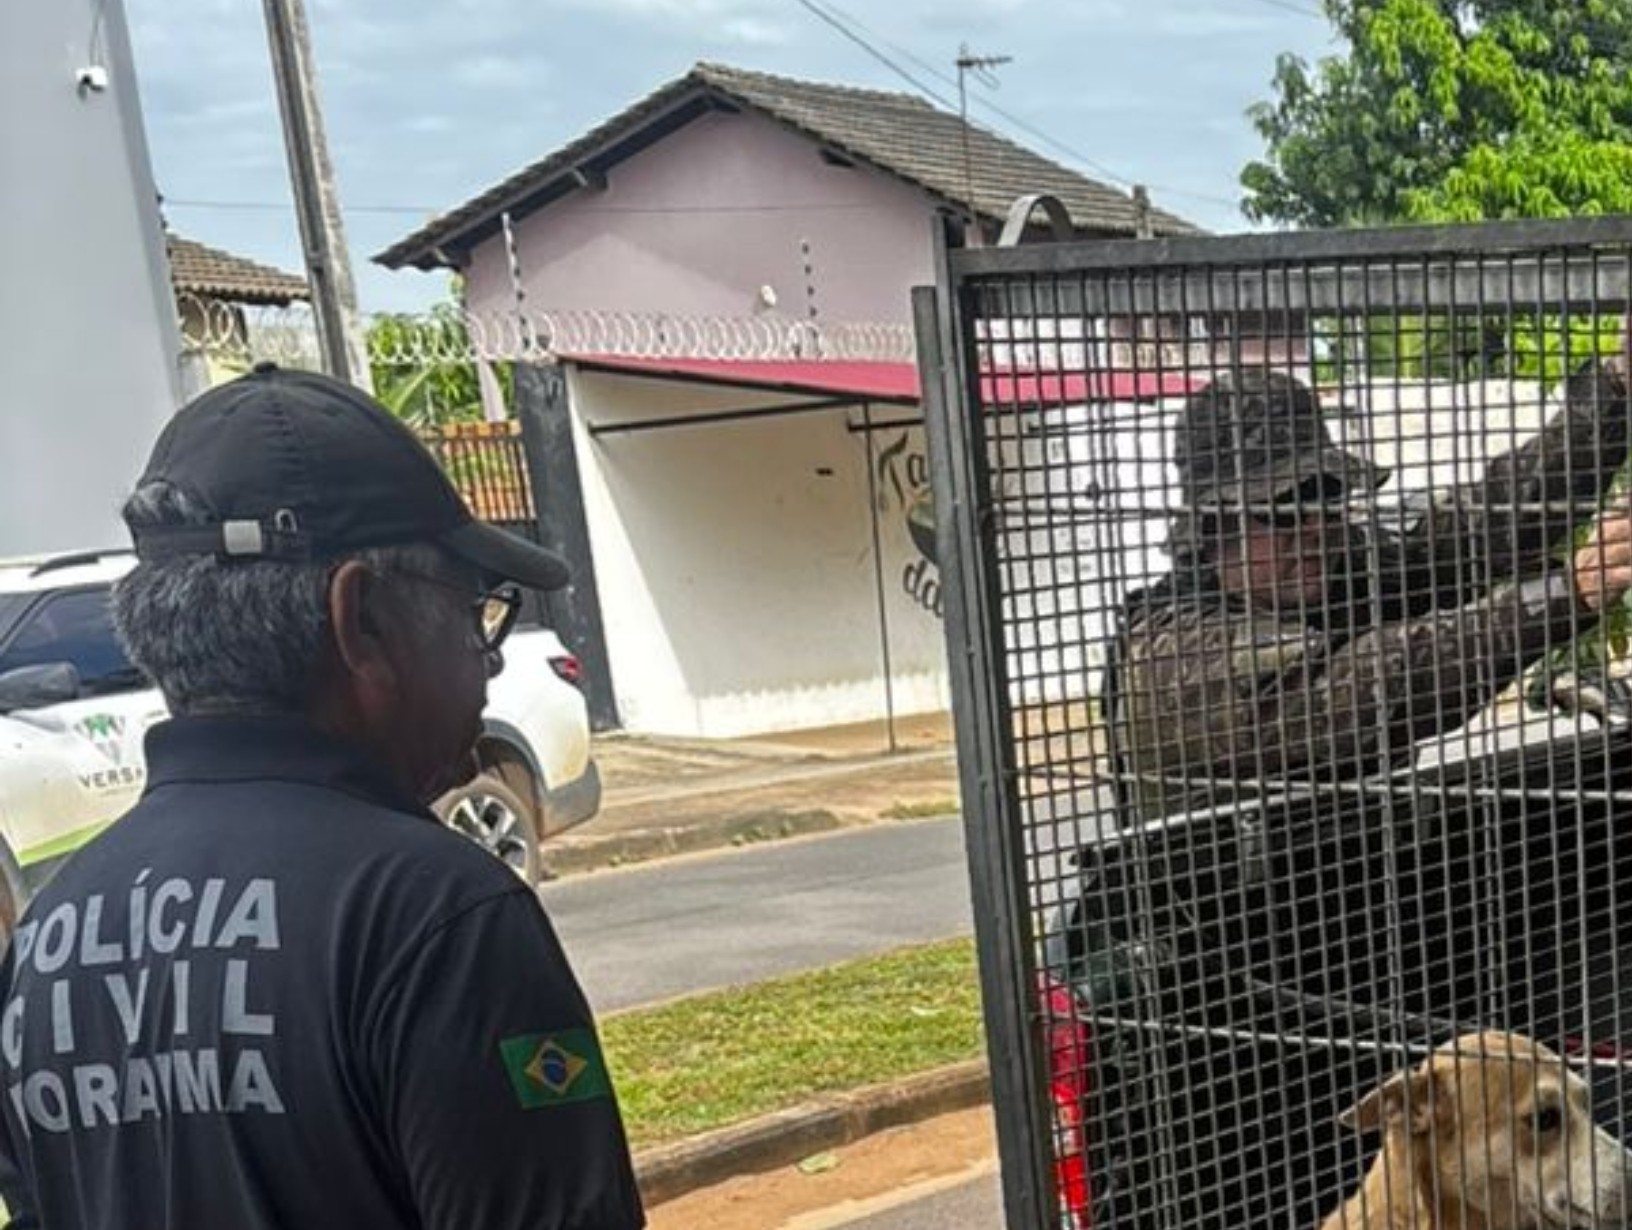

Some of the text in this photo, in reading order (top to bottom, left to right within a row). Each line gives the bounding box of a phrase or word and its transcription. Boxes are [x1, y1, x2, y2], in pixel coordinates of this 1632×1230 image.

[878, 431, 928, 510] Ta
[12, 867, 280, 986] POLÍCIA
[2, 959, 274, 1068] CIVIL
